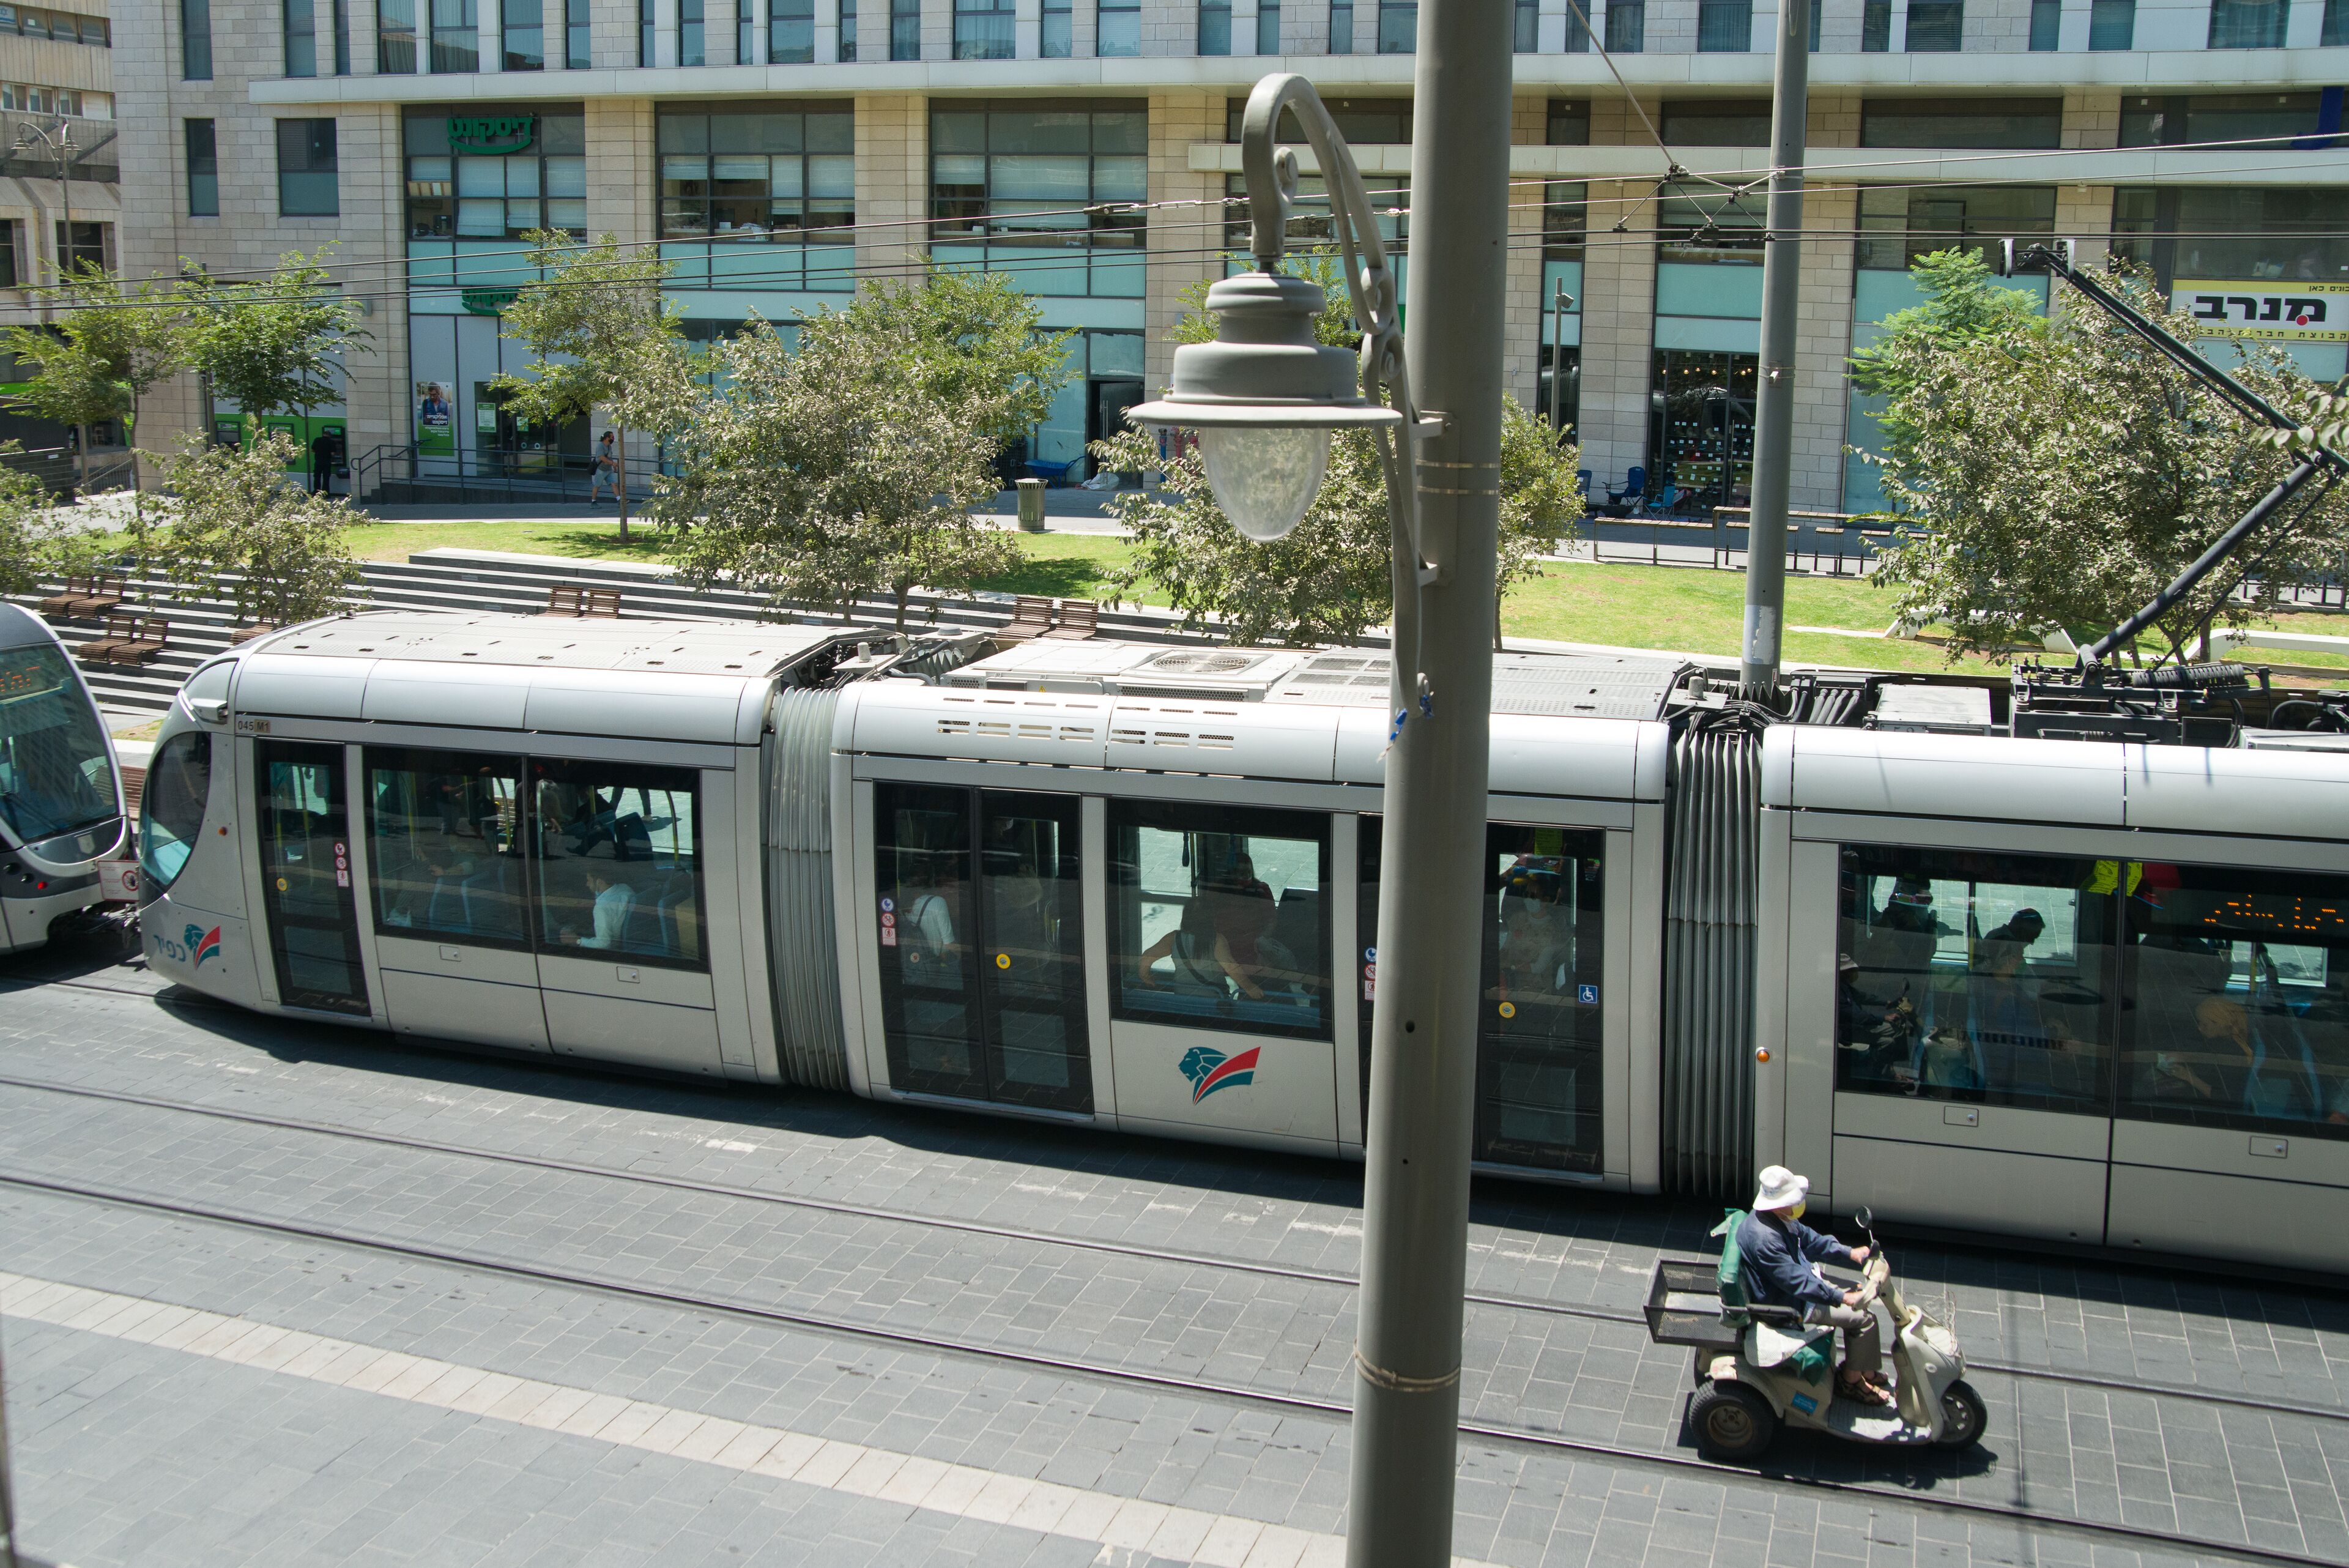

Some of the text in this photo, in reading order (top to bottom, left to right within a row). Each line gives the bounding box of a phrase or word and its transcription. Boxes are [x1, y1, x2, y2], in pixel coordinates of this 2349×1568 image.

[447, 117, 533, 143] דיסקונט
[2194, 296, 2326, 323] מנרב
[238, 721, 254, 730] 045
